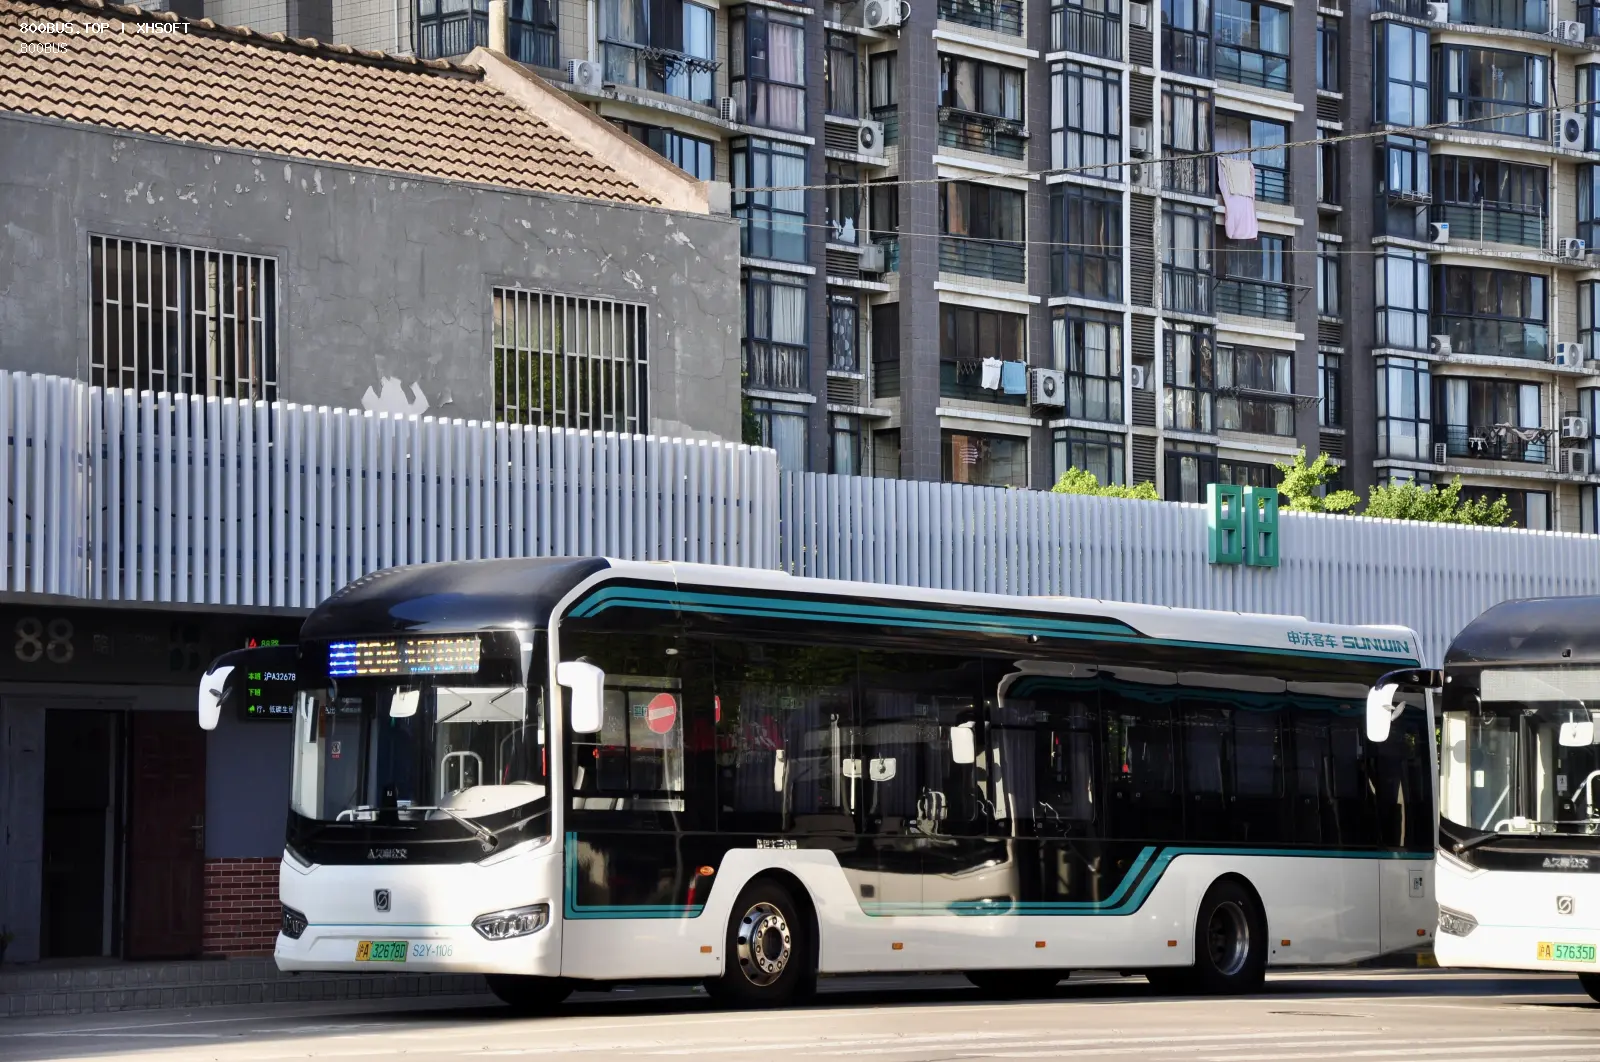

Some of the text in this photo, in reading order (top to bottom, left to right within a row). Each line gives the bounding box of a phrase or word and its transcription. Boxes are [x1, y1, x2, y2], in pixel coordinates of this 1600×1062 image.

[1207, 483, 1279, 567] 88
[14, 617, 75, 664] 88
[1287, 630, 1410, 654] 申沃客车 SUNWIN
[412, 944, 453, 957] S2Y-1106
